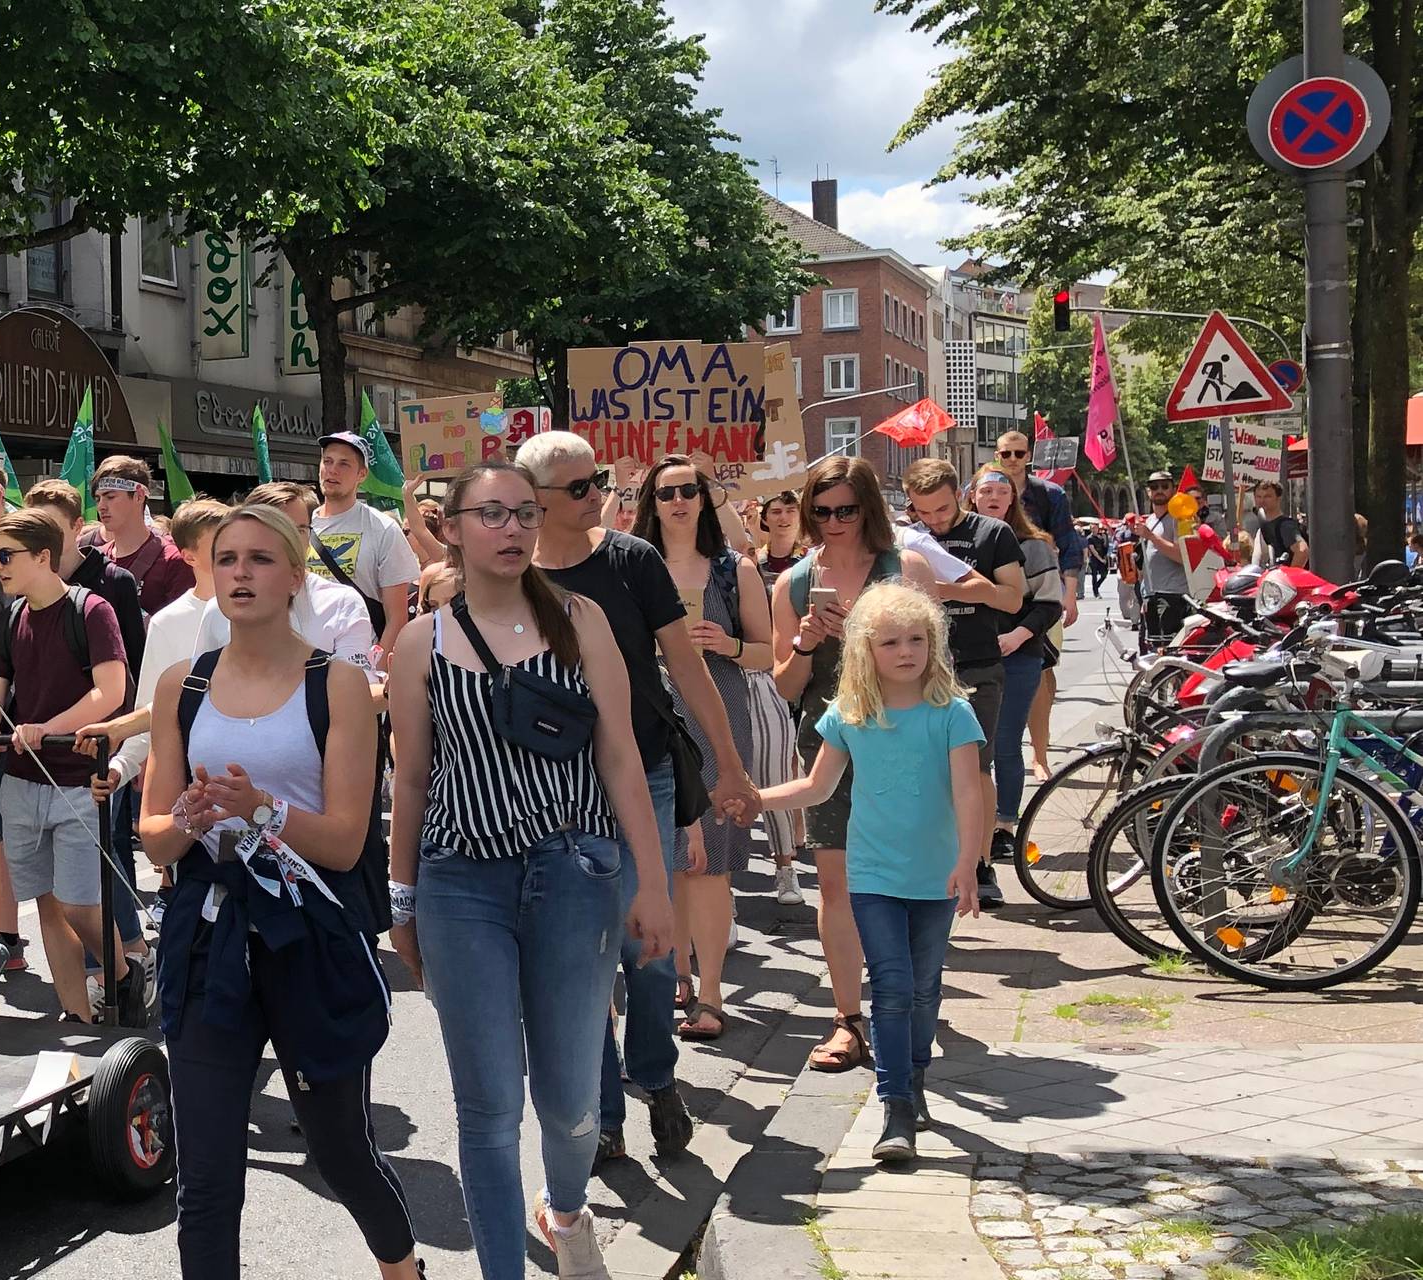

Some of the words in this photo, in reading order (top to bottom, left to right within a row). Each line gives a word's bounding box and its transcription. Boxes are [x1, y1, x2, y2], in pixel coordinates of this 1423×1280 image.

[30, 327, 62, 353] GALERIE
[612, 344, 749, 391] OMA,
[400, 404, 455, 425] There
[466, 400, 480, 419] is
[570, 388, 631, 422] WAS
[643, 387, 701, 421] IST
[708, 385, 766, 424] EIN
[442, 424, 467, 440] no
